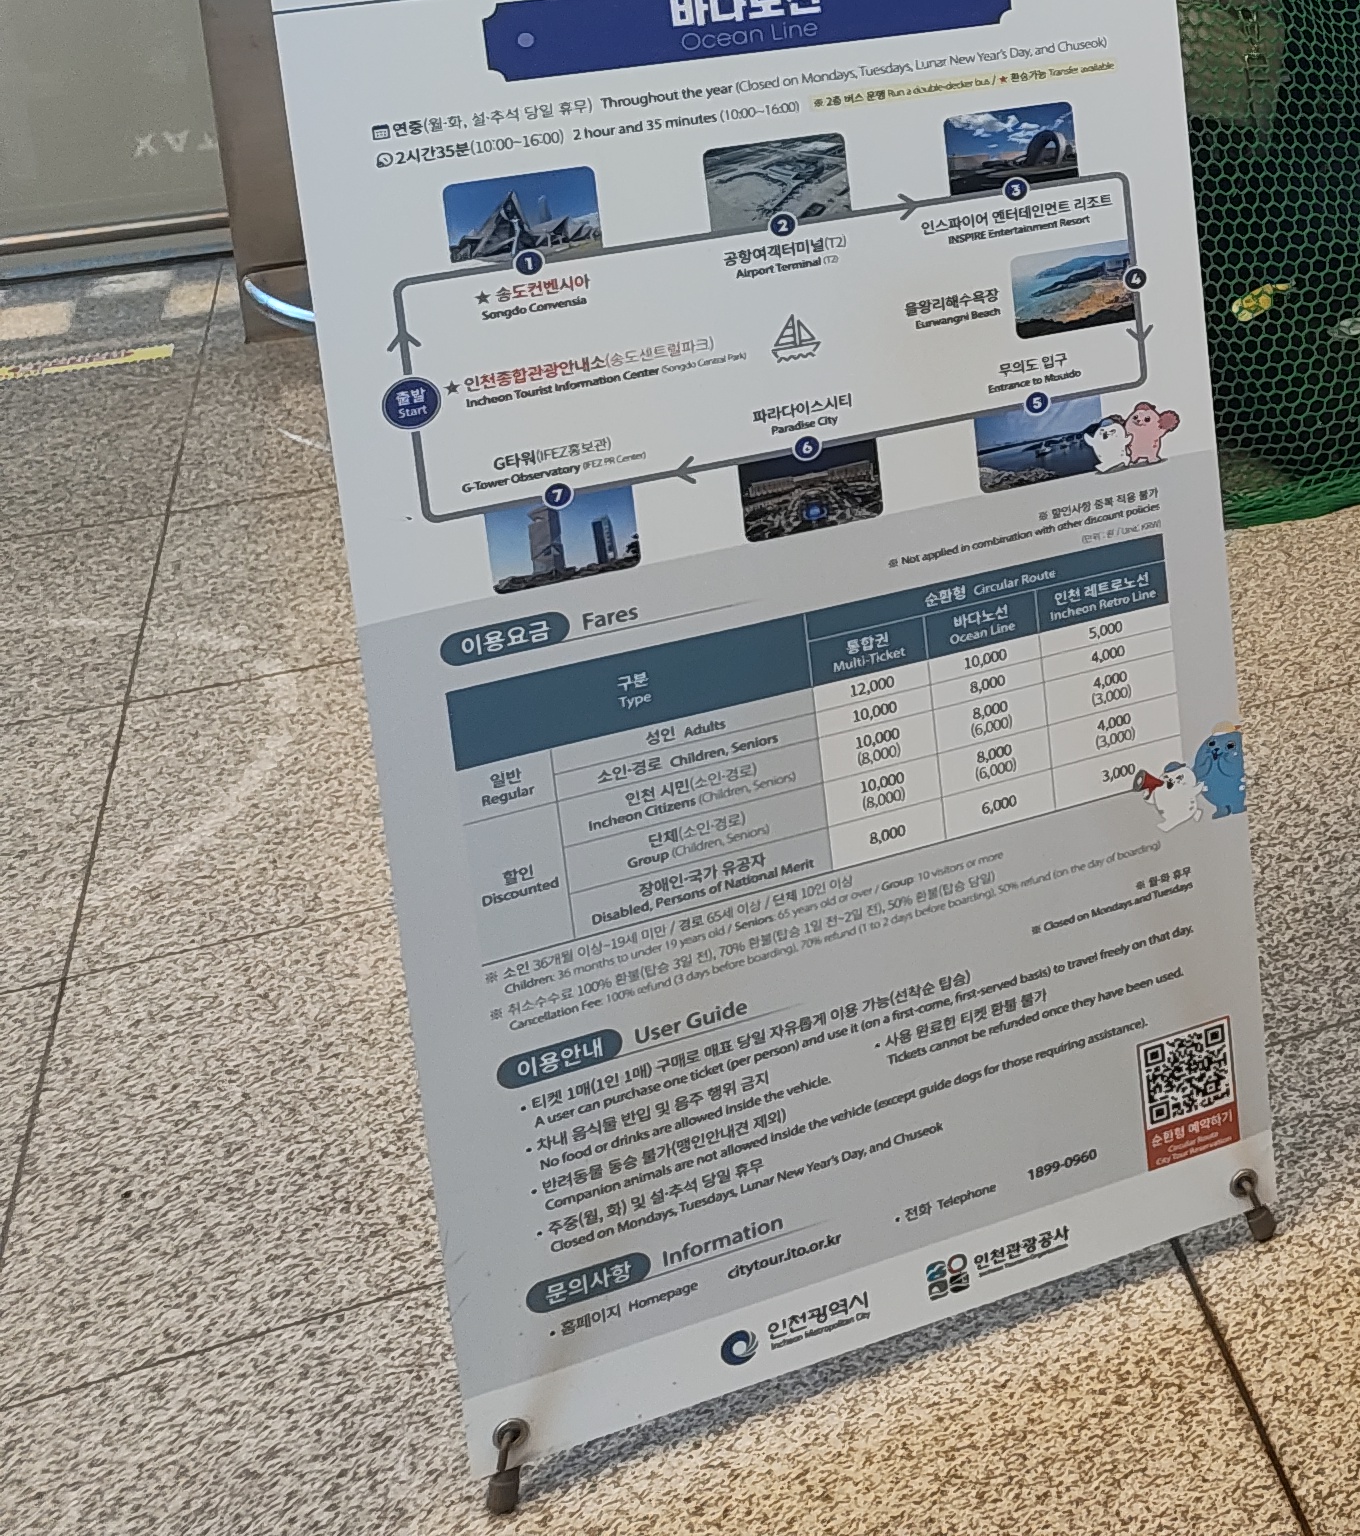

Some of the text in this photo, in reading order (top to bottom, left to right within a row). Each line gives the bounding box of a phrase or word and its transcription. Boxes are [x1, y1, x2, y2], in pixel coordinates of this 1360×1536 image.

[681, 19, 818, 52] Ocean Line
[752, 392, 853, 424] 파라다이스시티
[460, 605, 639, 656] 이용요금 Fares
[833, 647, 906, 673] Multi-Ticket
[850, 621, 1123, 698] 12,000 10,000 5,000
[618, 692, 652, 709] Type
[853, 645, 1126, 724] 10,000 8,000 4,000
[482, 877, 559, 907] Discounted
[516, 1001, 748, 1077] 이용안내 User Guide
[1027, 1149, 1098, 1181] 1899-0960
[545, 1216, 785, 1306] 문의사항 Information
[726, 1232, 842, 1280] citytour.ito.or.kr
[766, 1292, 870, 1340] 인천광역시
